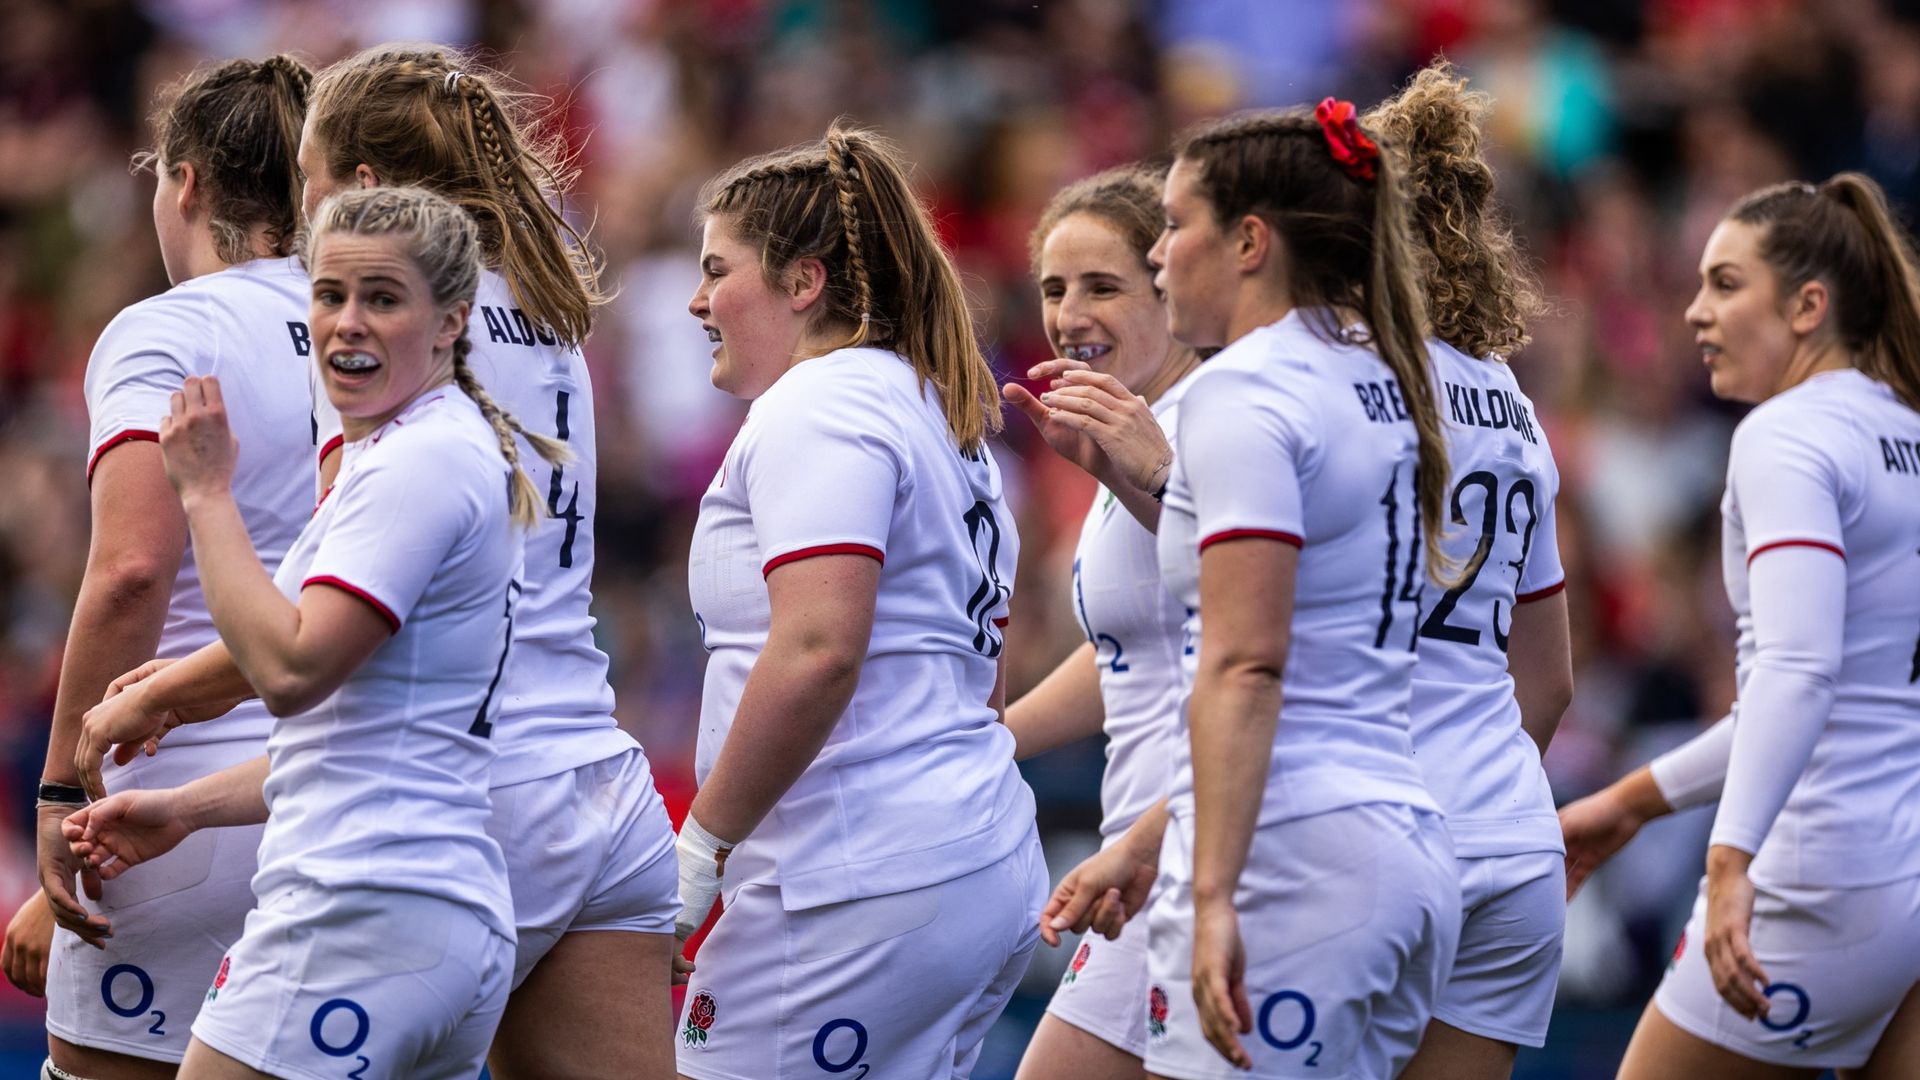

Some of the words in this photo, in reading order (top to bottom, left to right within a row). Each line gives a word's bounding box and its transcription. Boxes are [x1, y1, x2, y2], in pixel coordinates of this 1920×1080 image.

[1354, 380, 1412, 424] BRE
[1375, 463, 1425, 652] 14
[1419, 471, 1536, 652] 23
[101, 964, 166, 1036] O2
[1258, 990, 1323, 1067] O2
[1759, 983, 1813, 1050] O2
[310, 998, 370, 1080] O2
[813, 1018, 870, 1080] O2
